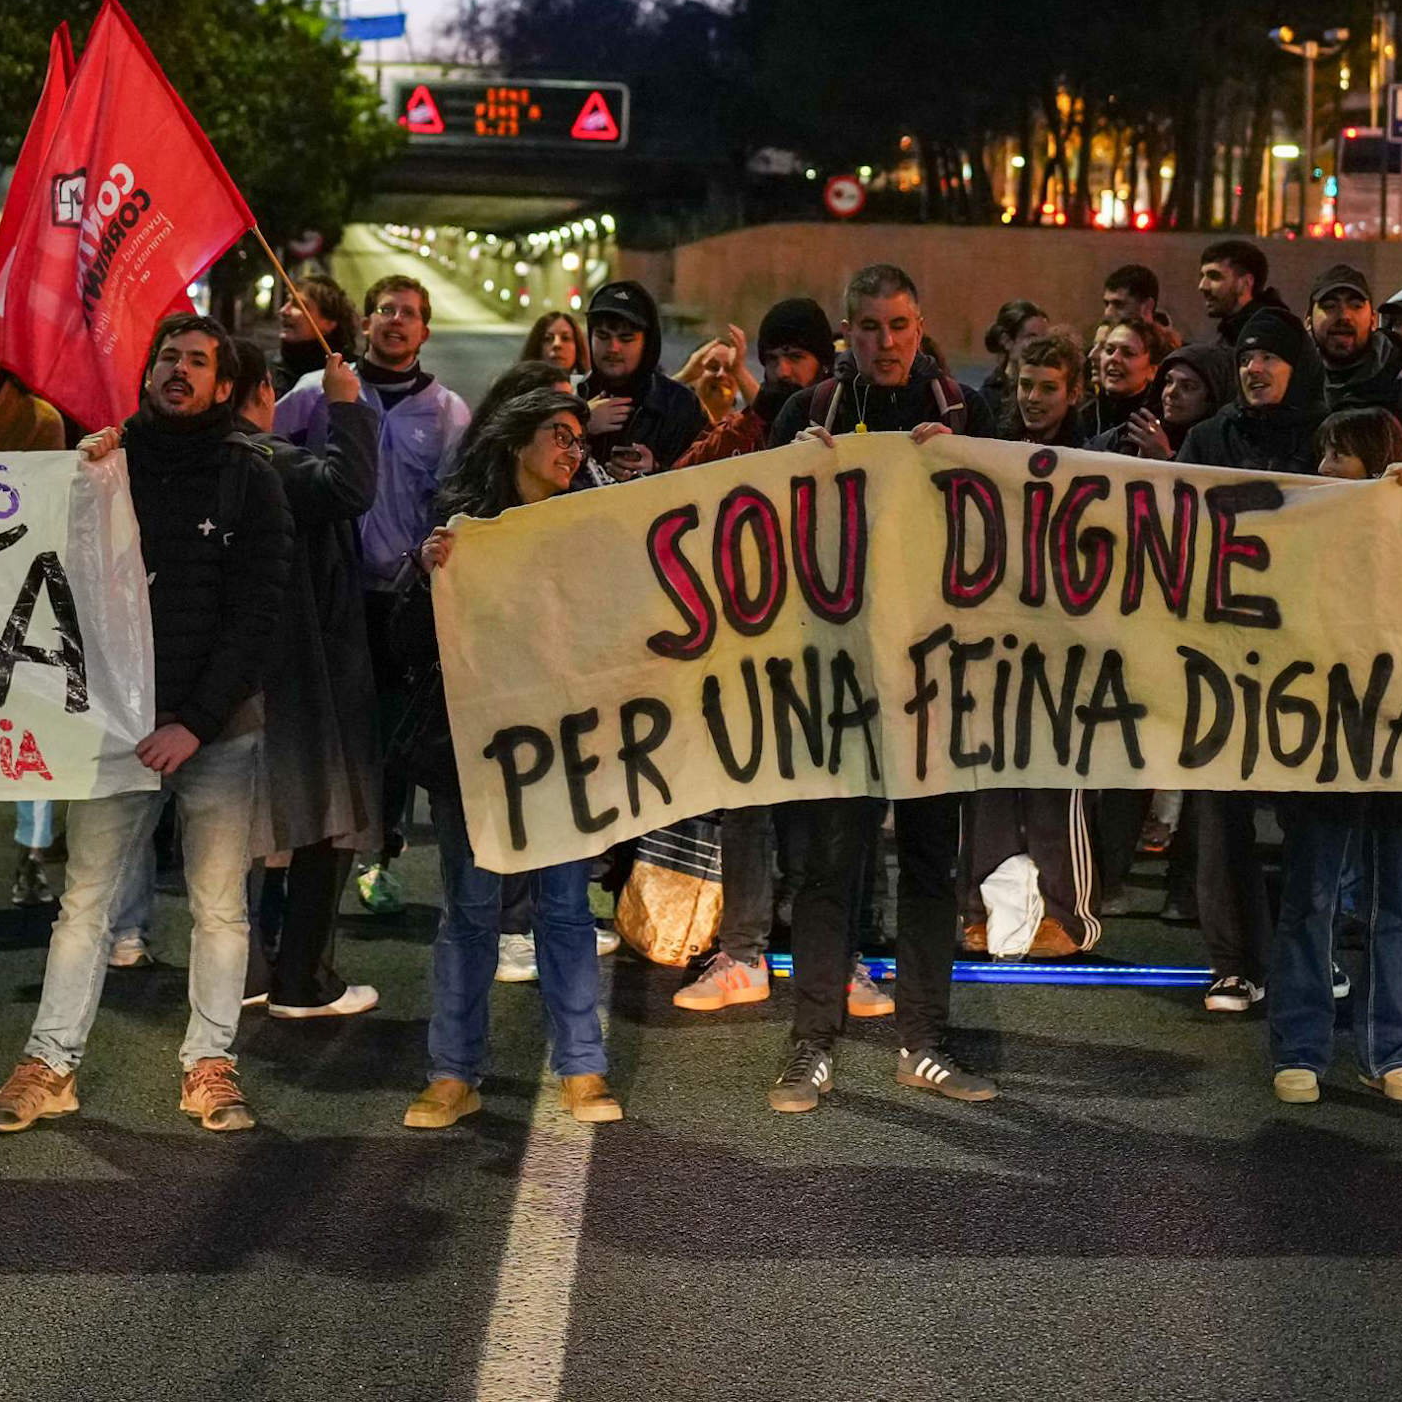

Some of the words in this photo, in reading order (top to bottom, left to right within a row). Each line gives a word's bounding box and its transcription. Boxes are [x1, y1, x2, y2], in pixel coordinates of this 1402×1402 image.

[646, 467, 868, 661] SOU
[483, 697, 672, 852] PER
[702, 646, 881, 784] UNA
